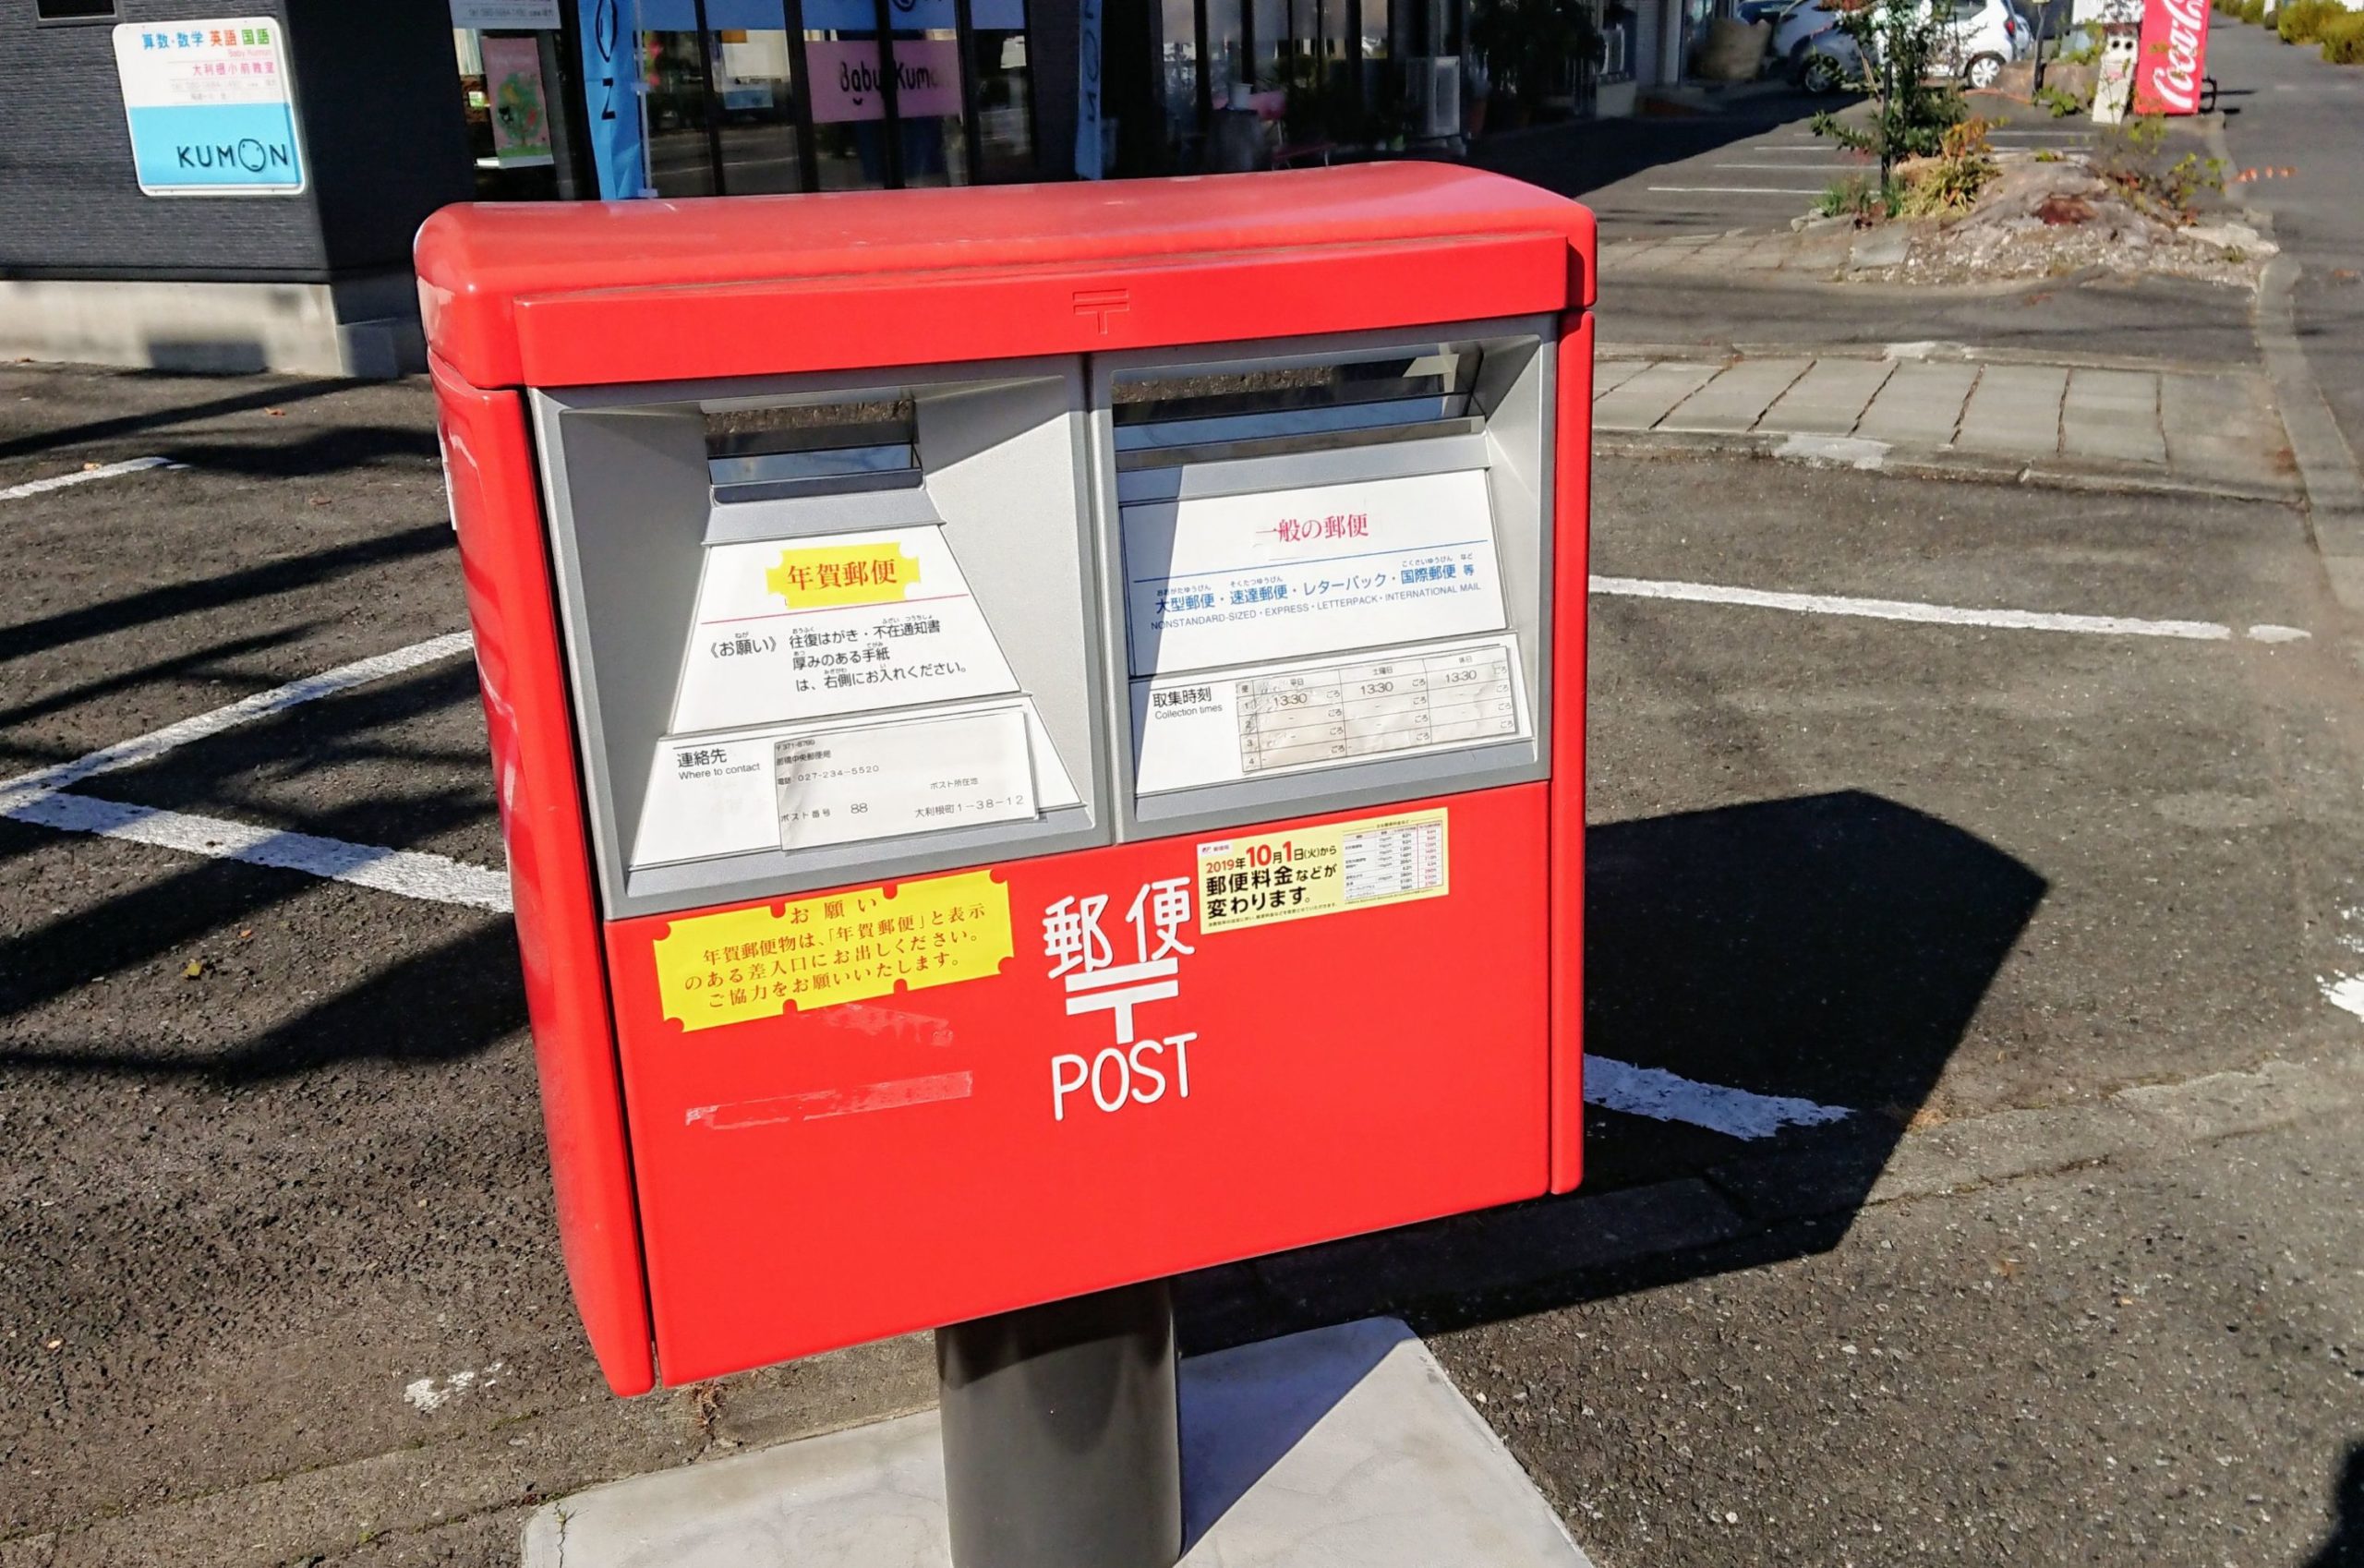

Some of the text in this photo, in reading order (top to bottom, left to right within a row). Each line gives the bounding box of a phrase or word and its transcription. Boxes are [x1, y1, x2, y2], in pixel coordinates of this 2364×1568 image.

[210, 30, 237, 46] 英語
[241, 28, 271, 45] 国語
[176, 139, 289, 173] KUMON
[1255, 513, 1369, 543] 一般の郵便
[787, 559, 898, 591] 年賀郵便
[1151, 582, 1481, 630] NONSTANDARD-SIZED EXPRESS LETTERPACK INTERNATIONAL MAIL
[790, 620, 940, 649] 往復はがき・不在通知書
[792, 646, 890, 670] 厚みのある手紙
[796, 662, 966, 692] は、右側にお入れください。
[1412, 678, 1426, 687] ごろ
[1152, 686, 1212, 708] 取集時刻
[1155, 705, 1223, 719] Collection times
[677, 748, 727, 767] 連絡先
[679, 769, 710, 779] Where
[726, 763, 760, 774] contact
[930, 778, 979, 790] ポスト所在地
[850, 802, 868, 814] 88
[1206, 863, 1337, 897] 郵便料金などが
[790, 897, 877, 924] お願い
[1207, 887, 1309, 919] 変わります。
[703, 901, 986, 967] 年賀郵便物は、「年賀郵便」と表示
[1042, 876, 1196, 979] 郵便
[684, 931, 978, 992] のある差入口にお出しください。
[709, 951, 959, 1008] ご協力をお願いいたします。
[1051, 1031, 1198, 1121] POST
